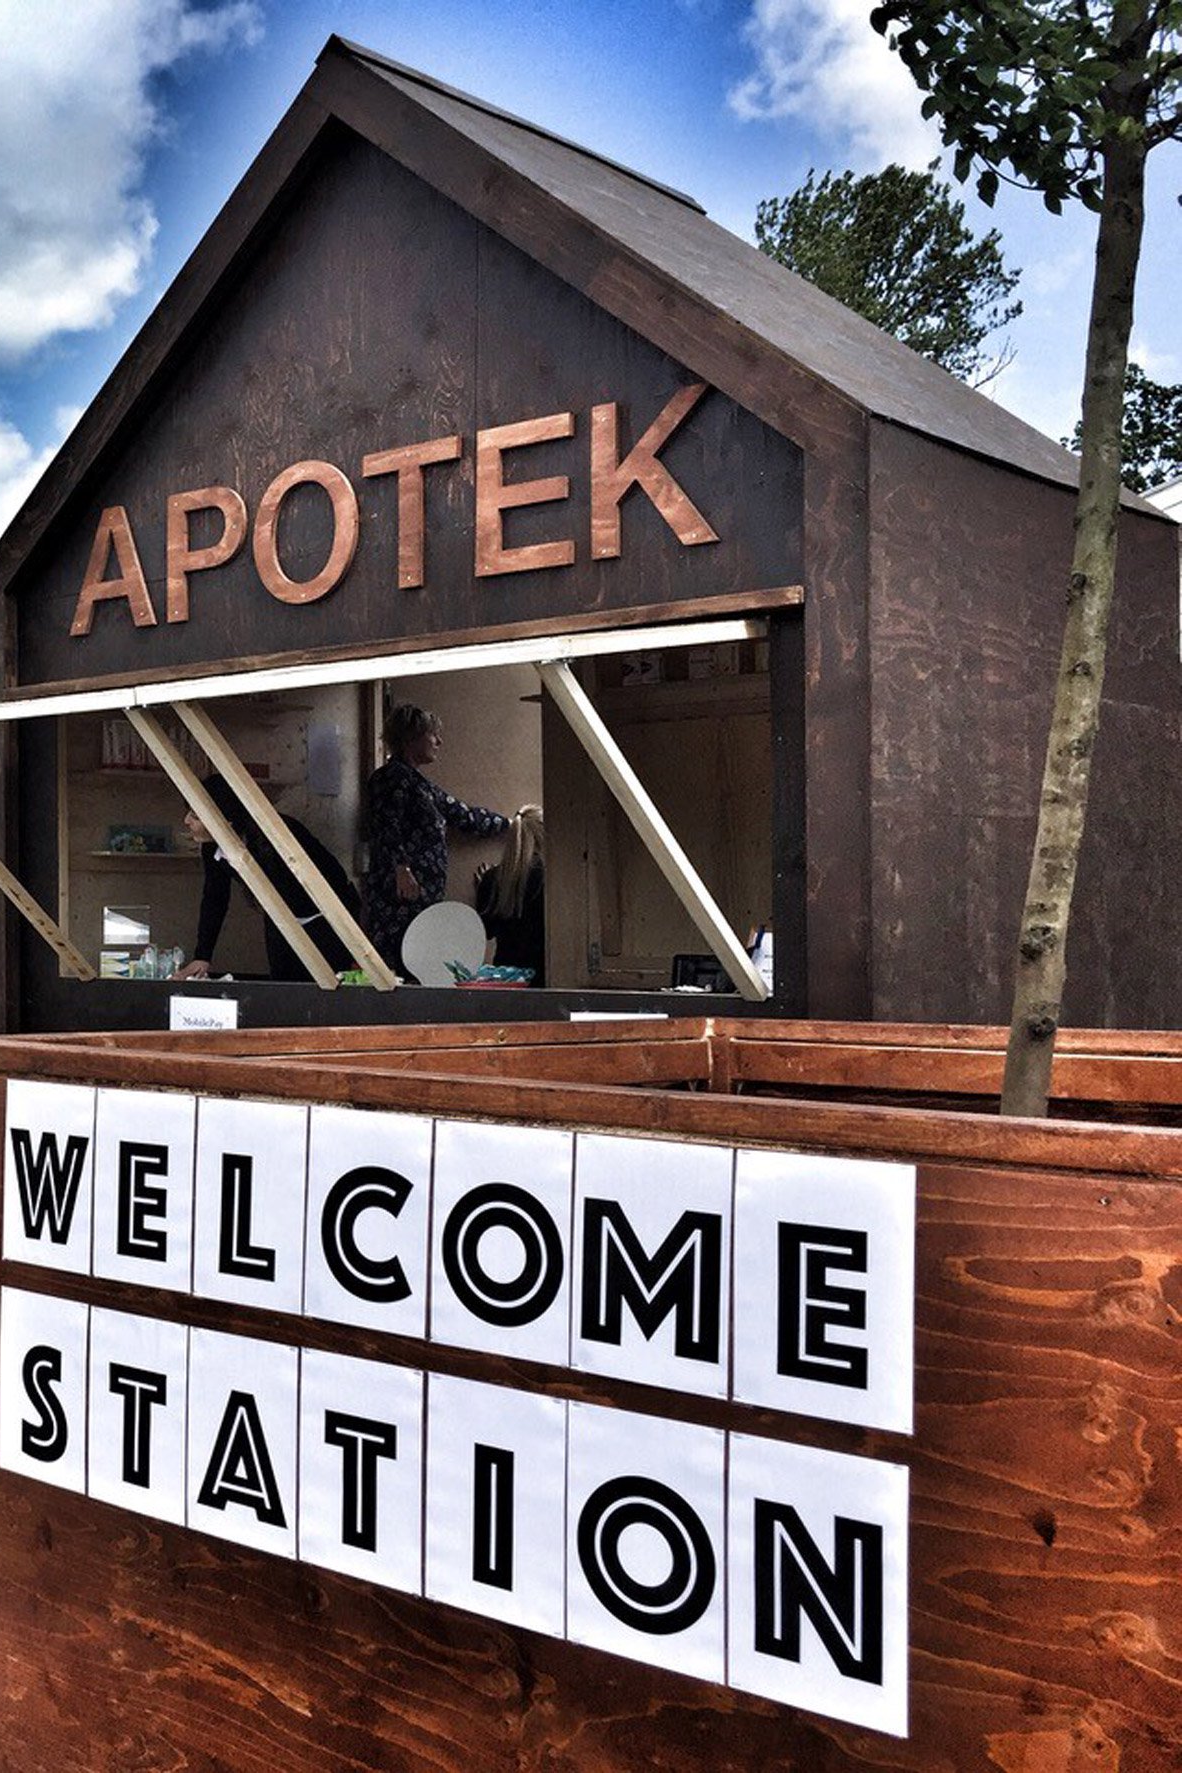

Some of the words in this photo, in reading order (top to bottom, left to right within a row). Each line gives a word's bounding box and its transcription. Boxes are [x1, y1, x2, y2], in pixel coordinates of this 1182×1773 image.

[69, 382, 720, 637] APOTEK
[10, 1127, 869, 1392] WELCOME
[20, 1345, 885, 1687] STATION
